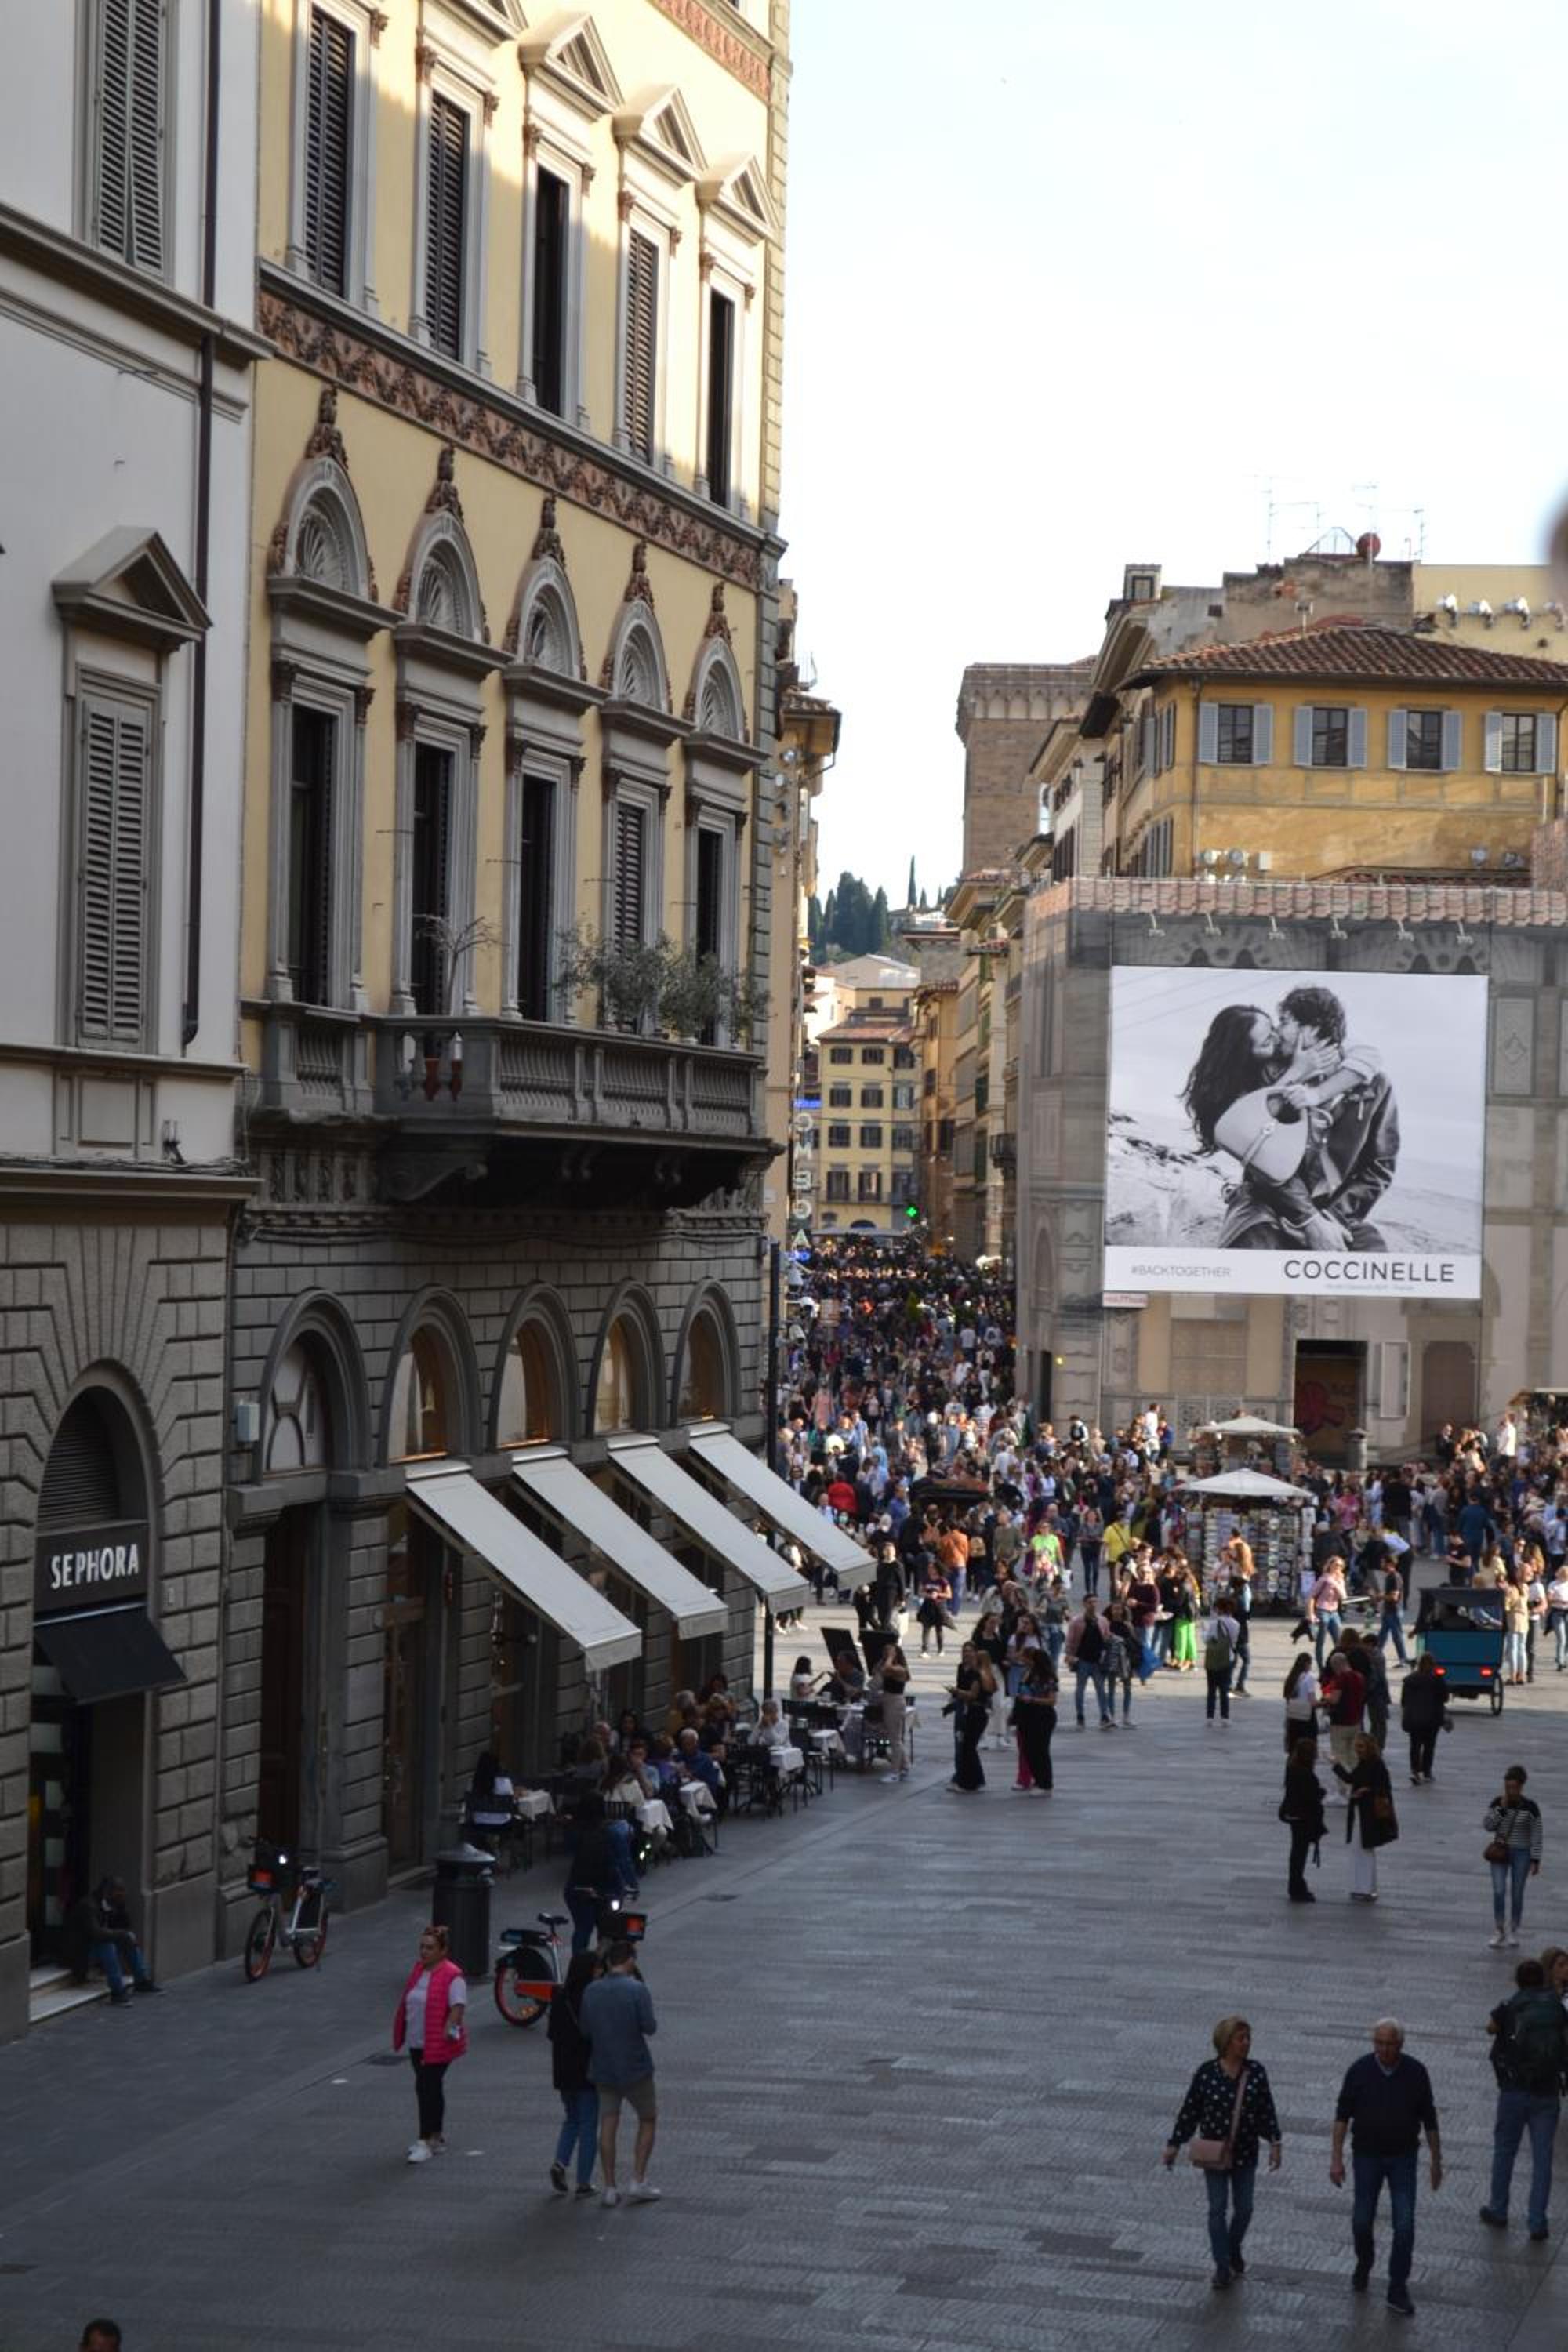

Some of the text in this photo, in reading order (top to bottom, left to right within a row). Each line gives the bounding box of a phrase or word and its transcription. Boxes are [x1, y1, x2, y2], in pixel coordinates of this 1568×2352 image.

[1131, 1265, 1230, 1278] #BACKTOGETHER
[1284, 1260, 1454, 1282] COCCINELLE
[50, 1544, 139, 1590] SEPHORA
